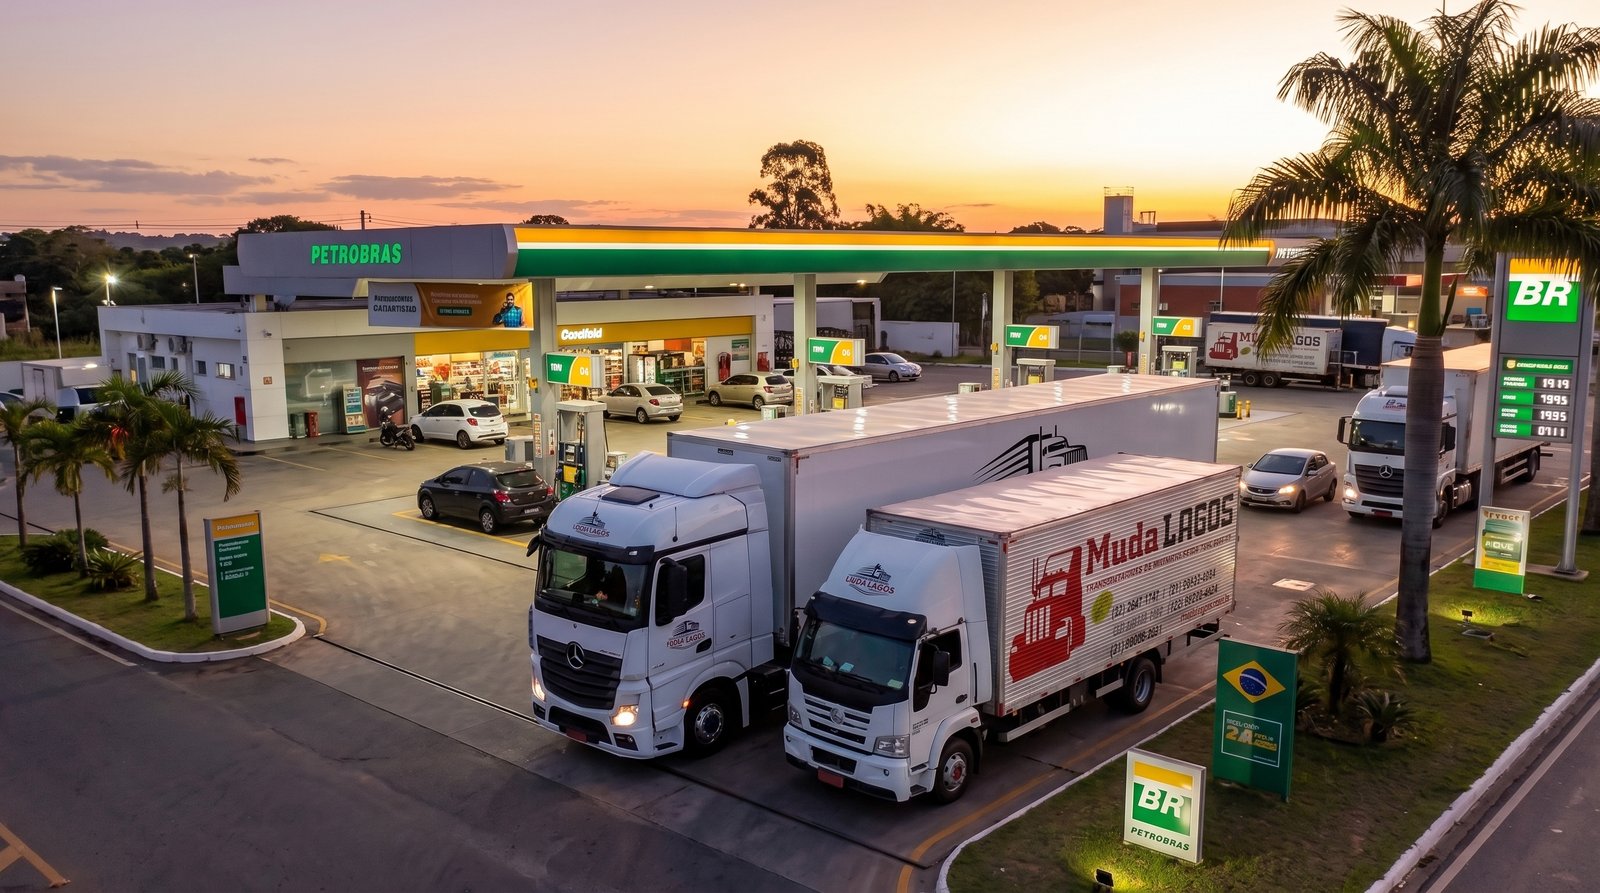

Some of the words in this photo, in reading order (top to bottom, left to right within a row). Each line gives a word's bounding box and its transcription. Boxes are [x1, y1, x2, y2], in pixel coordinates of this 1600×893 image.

[311, 243, 402, 265] PETROBRAS
[1513, 279, 1573, 307] BR
[1086, 521, 1159, 575] Muda
[1163, 493, 1234, 549] LAGOS
[867, 581, 896, 594] LAGOS
[1138, 783, 1185, 819] BR
[1130, 826, 1190, 851] PETROBRAS
